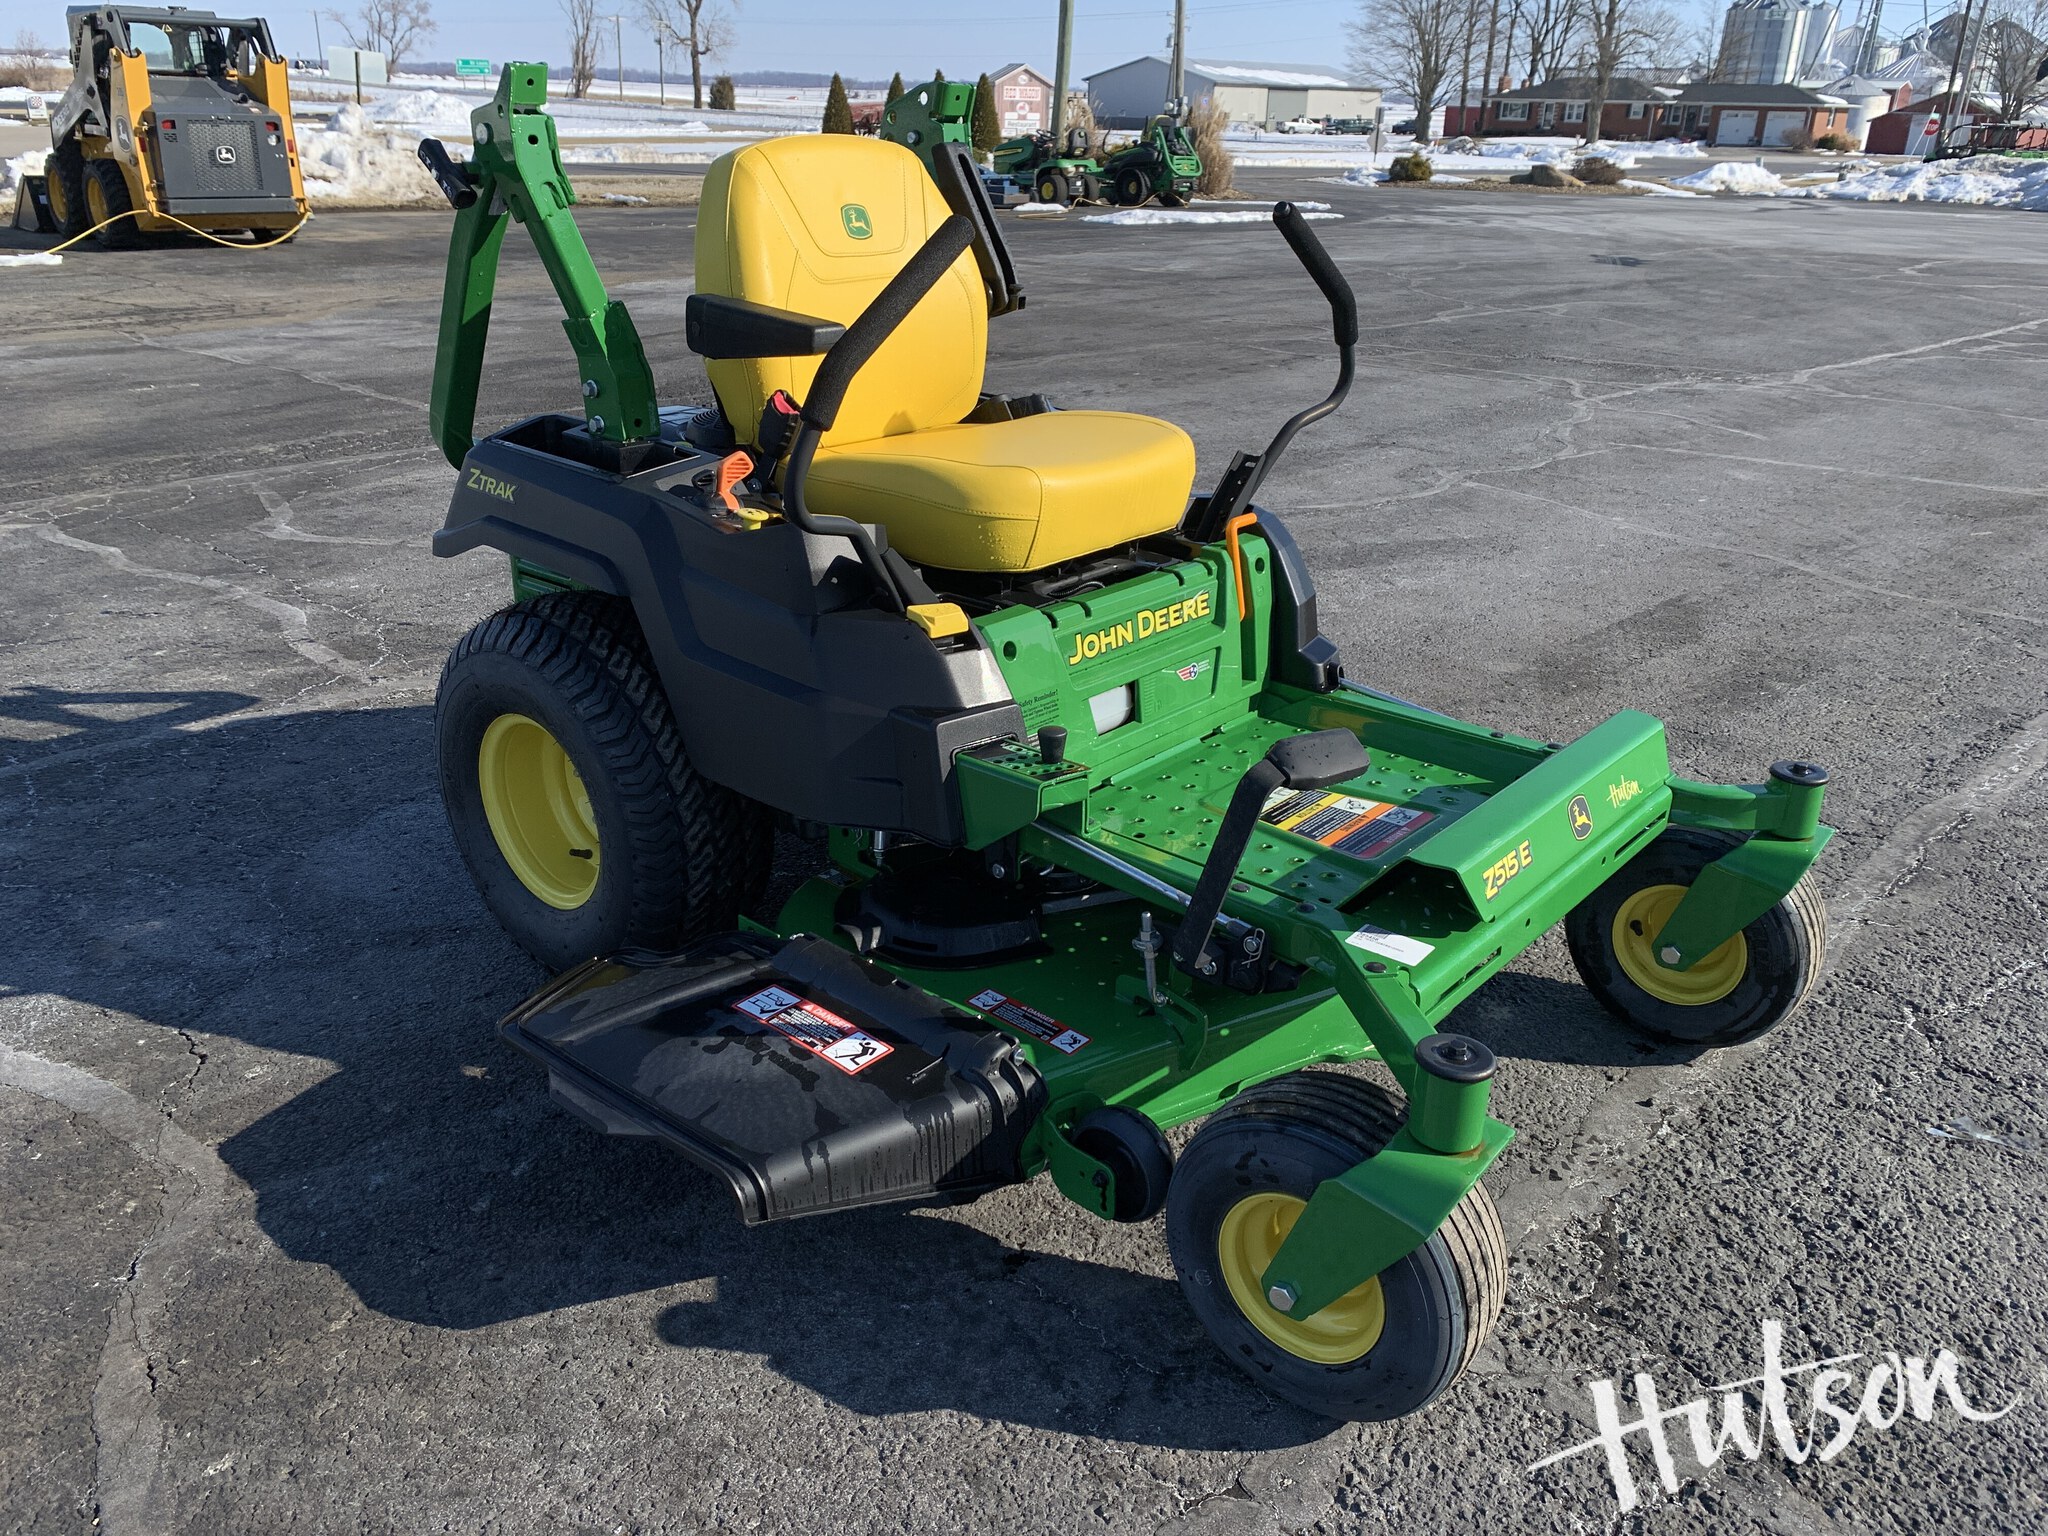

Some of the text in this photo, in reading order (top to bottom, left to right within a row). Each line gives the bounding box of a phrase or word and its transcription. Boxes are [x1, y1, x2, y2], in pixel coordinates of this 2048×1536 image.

[467, 468, 516, 501] ZTRAK
[1069, 592, 1210, 665] JOHN DEERE
[1606, 775, 1643, 808] Hutson
[1482, 839, 1533, 901] Z515 E
[813, 1008, 850, 1031] DANGER
[1026, 1006, 1055, 1024] DANGER
